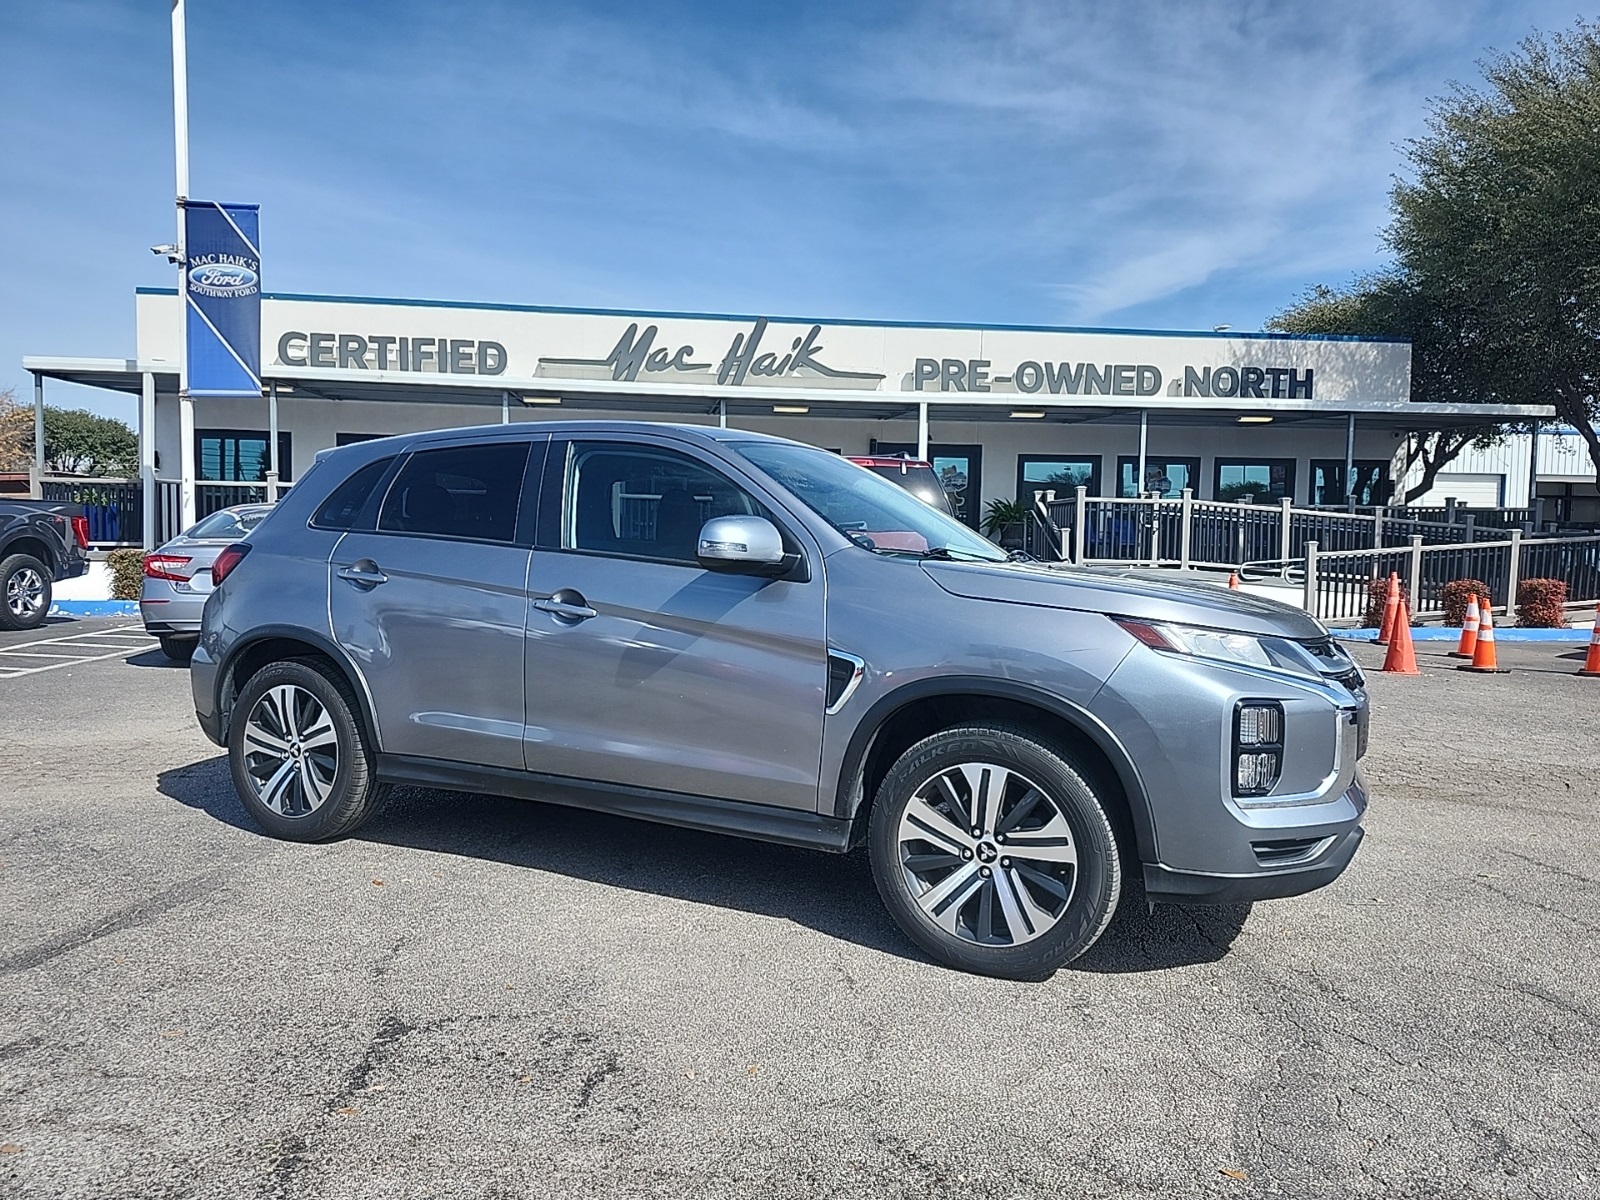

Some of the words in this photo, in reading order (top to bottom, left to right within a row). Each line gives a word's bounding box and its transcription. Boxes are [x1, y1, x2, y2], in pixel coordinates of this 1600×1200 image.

[189, 254, 216, 267] MAC
[219, 253, 258, 271] HAIK'S
[201, 268, 244, 286] Ford
[189, 283, 233, 298] SOUTHWAY
[234, 286, 258, 297] FORD
[278, 331, 508, 376] CERTIFIED
[538, 323, 711, 382] Mac
[717, 316, 886, 386] Haik
[914, 358, 1162, 397] PRE-OWNED
[1183, 365, 1314, 400] NORTH
